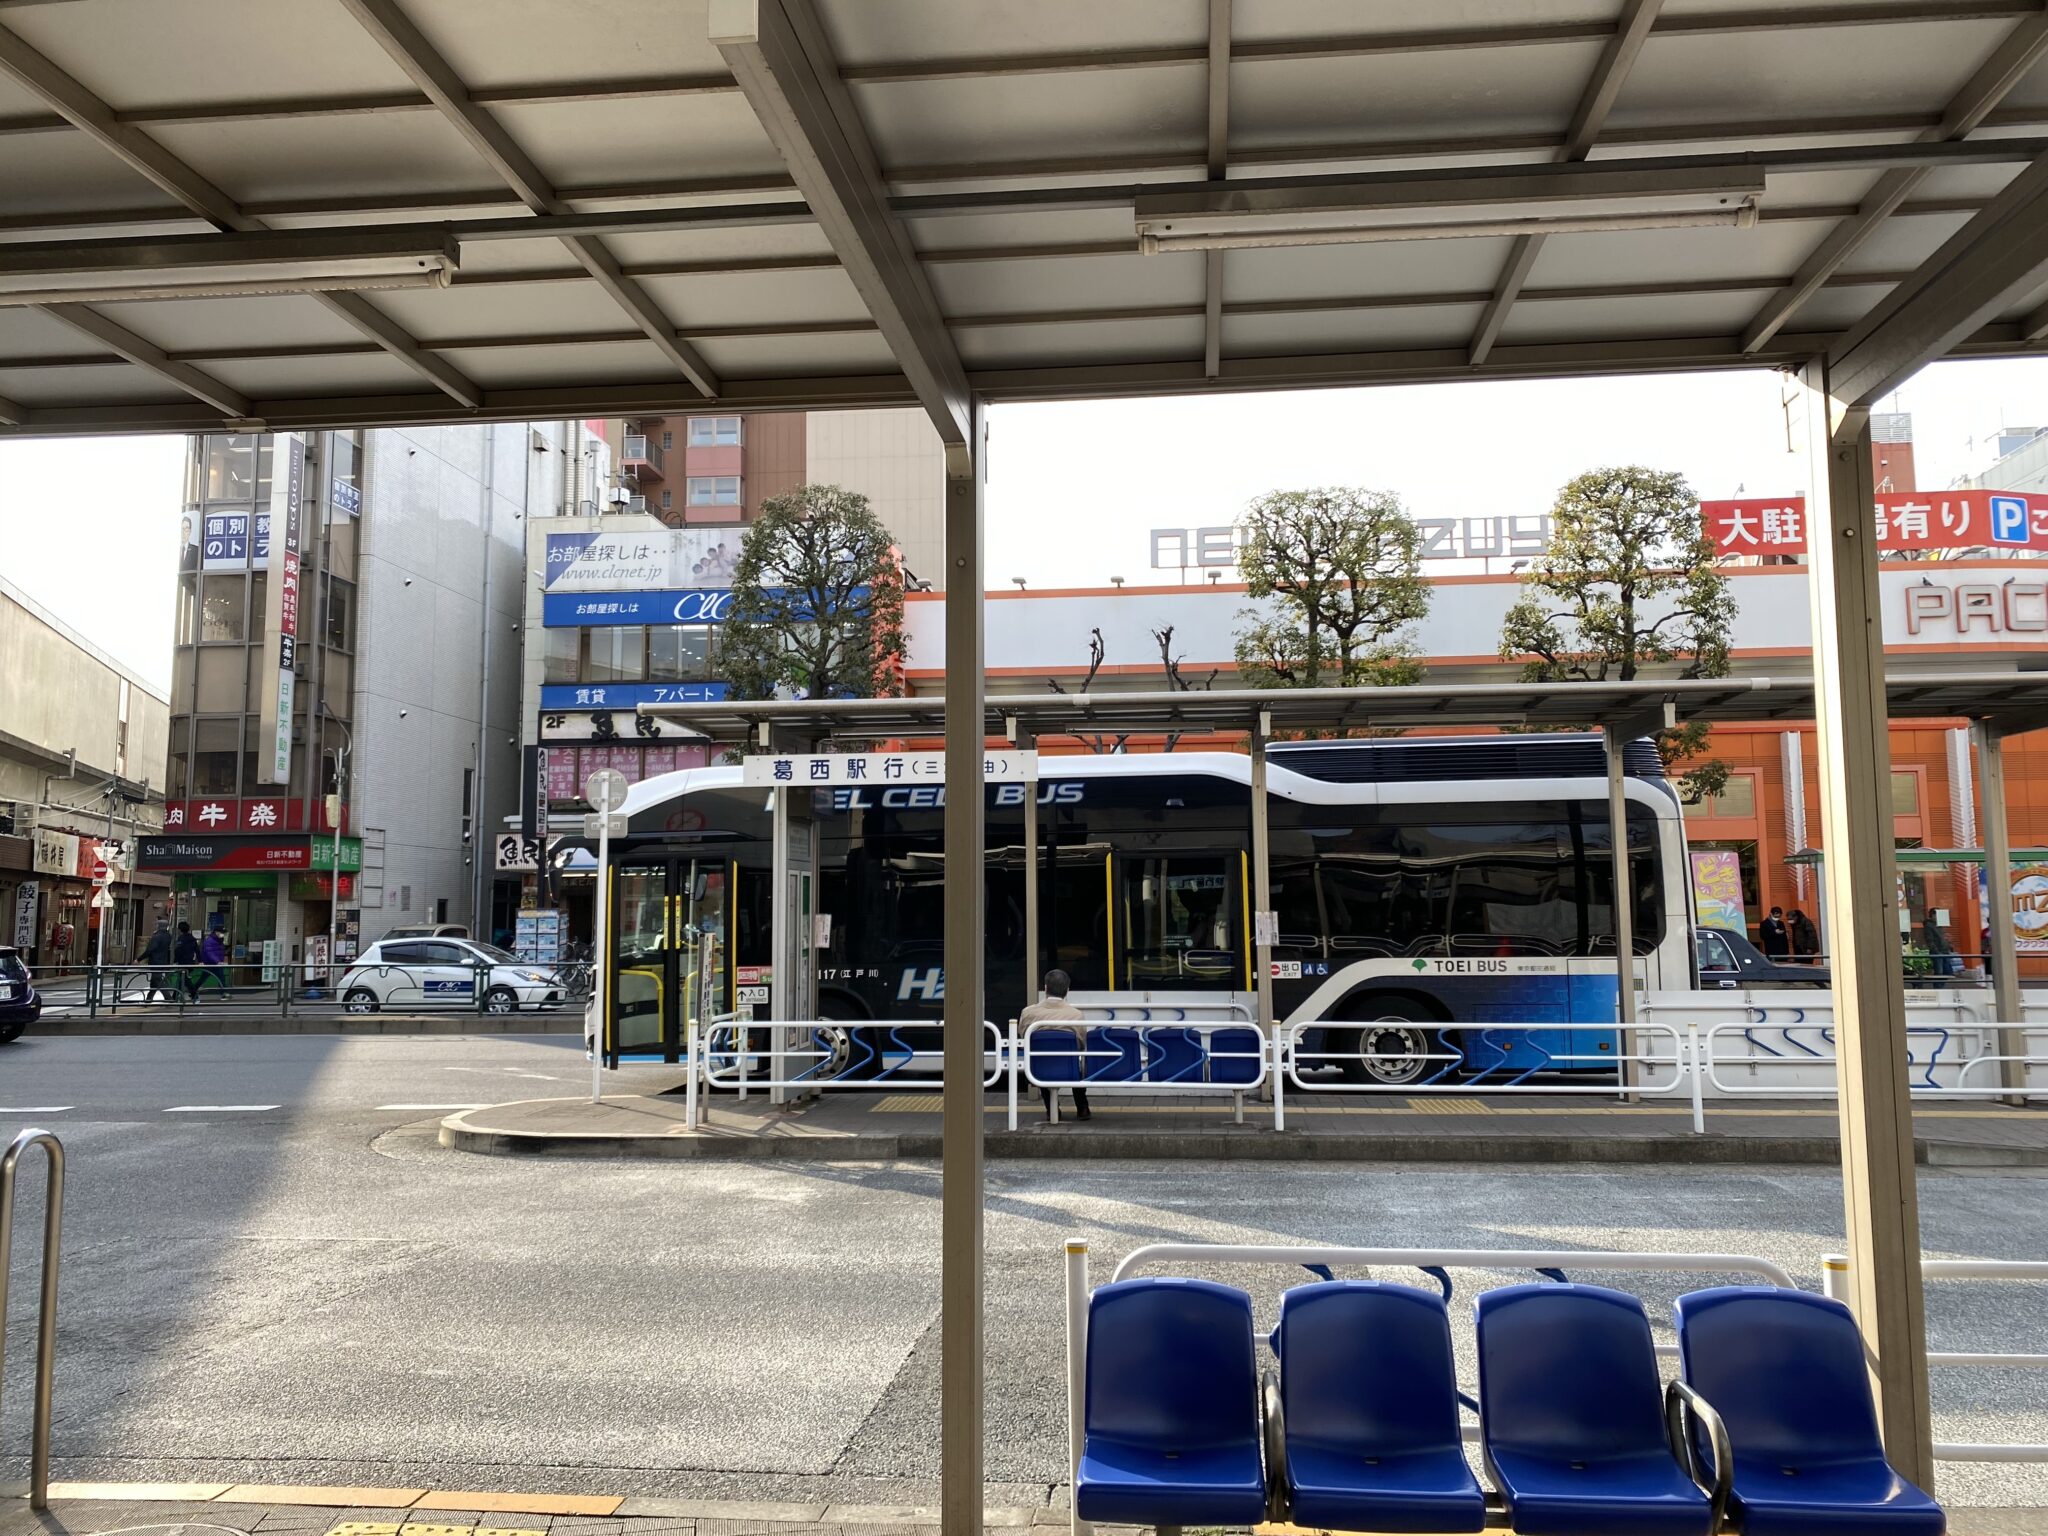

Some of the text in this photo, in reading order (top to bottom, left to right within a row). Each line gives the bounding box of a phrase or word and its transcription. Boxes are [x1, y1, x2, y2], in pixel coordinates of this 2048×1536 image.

[333, 493, 360, 514] のトライ
[1718, 500, 1970, 546] 大駐有り
[287, 538, 297, 548] 3F
[561, 565, 662, 582] www.clcnet.jp
[576, 603, 640, 615] お部屋探しは
[576, 687, 715, 704] 賃貸 アパート
[276, 683, 290, 771] 日新不動産
[545, 716, 567, 729] 2F
[553, 791, 573, 799] TEL
[994, 783, 1084, 805] BUS
[146, 844, 213, 855] Sha Maison
[266, 850, 302, 859] 日新不動産
[17, 884, 36, 945] 餃子専門店
[1281, 963, 1300, 972] 出口
[1434, 960, 1508, 973] TOEI BUS
[748, 988, 765, 997] 入口
